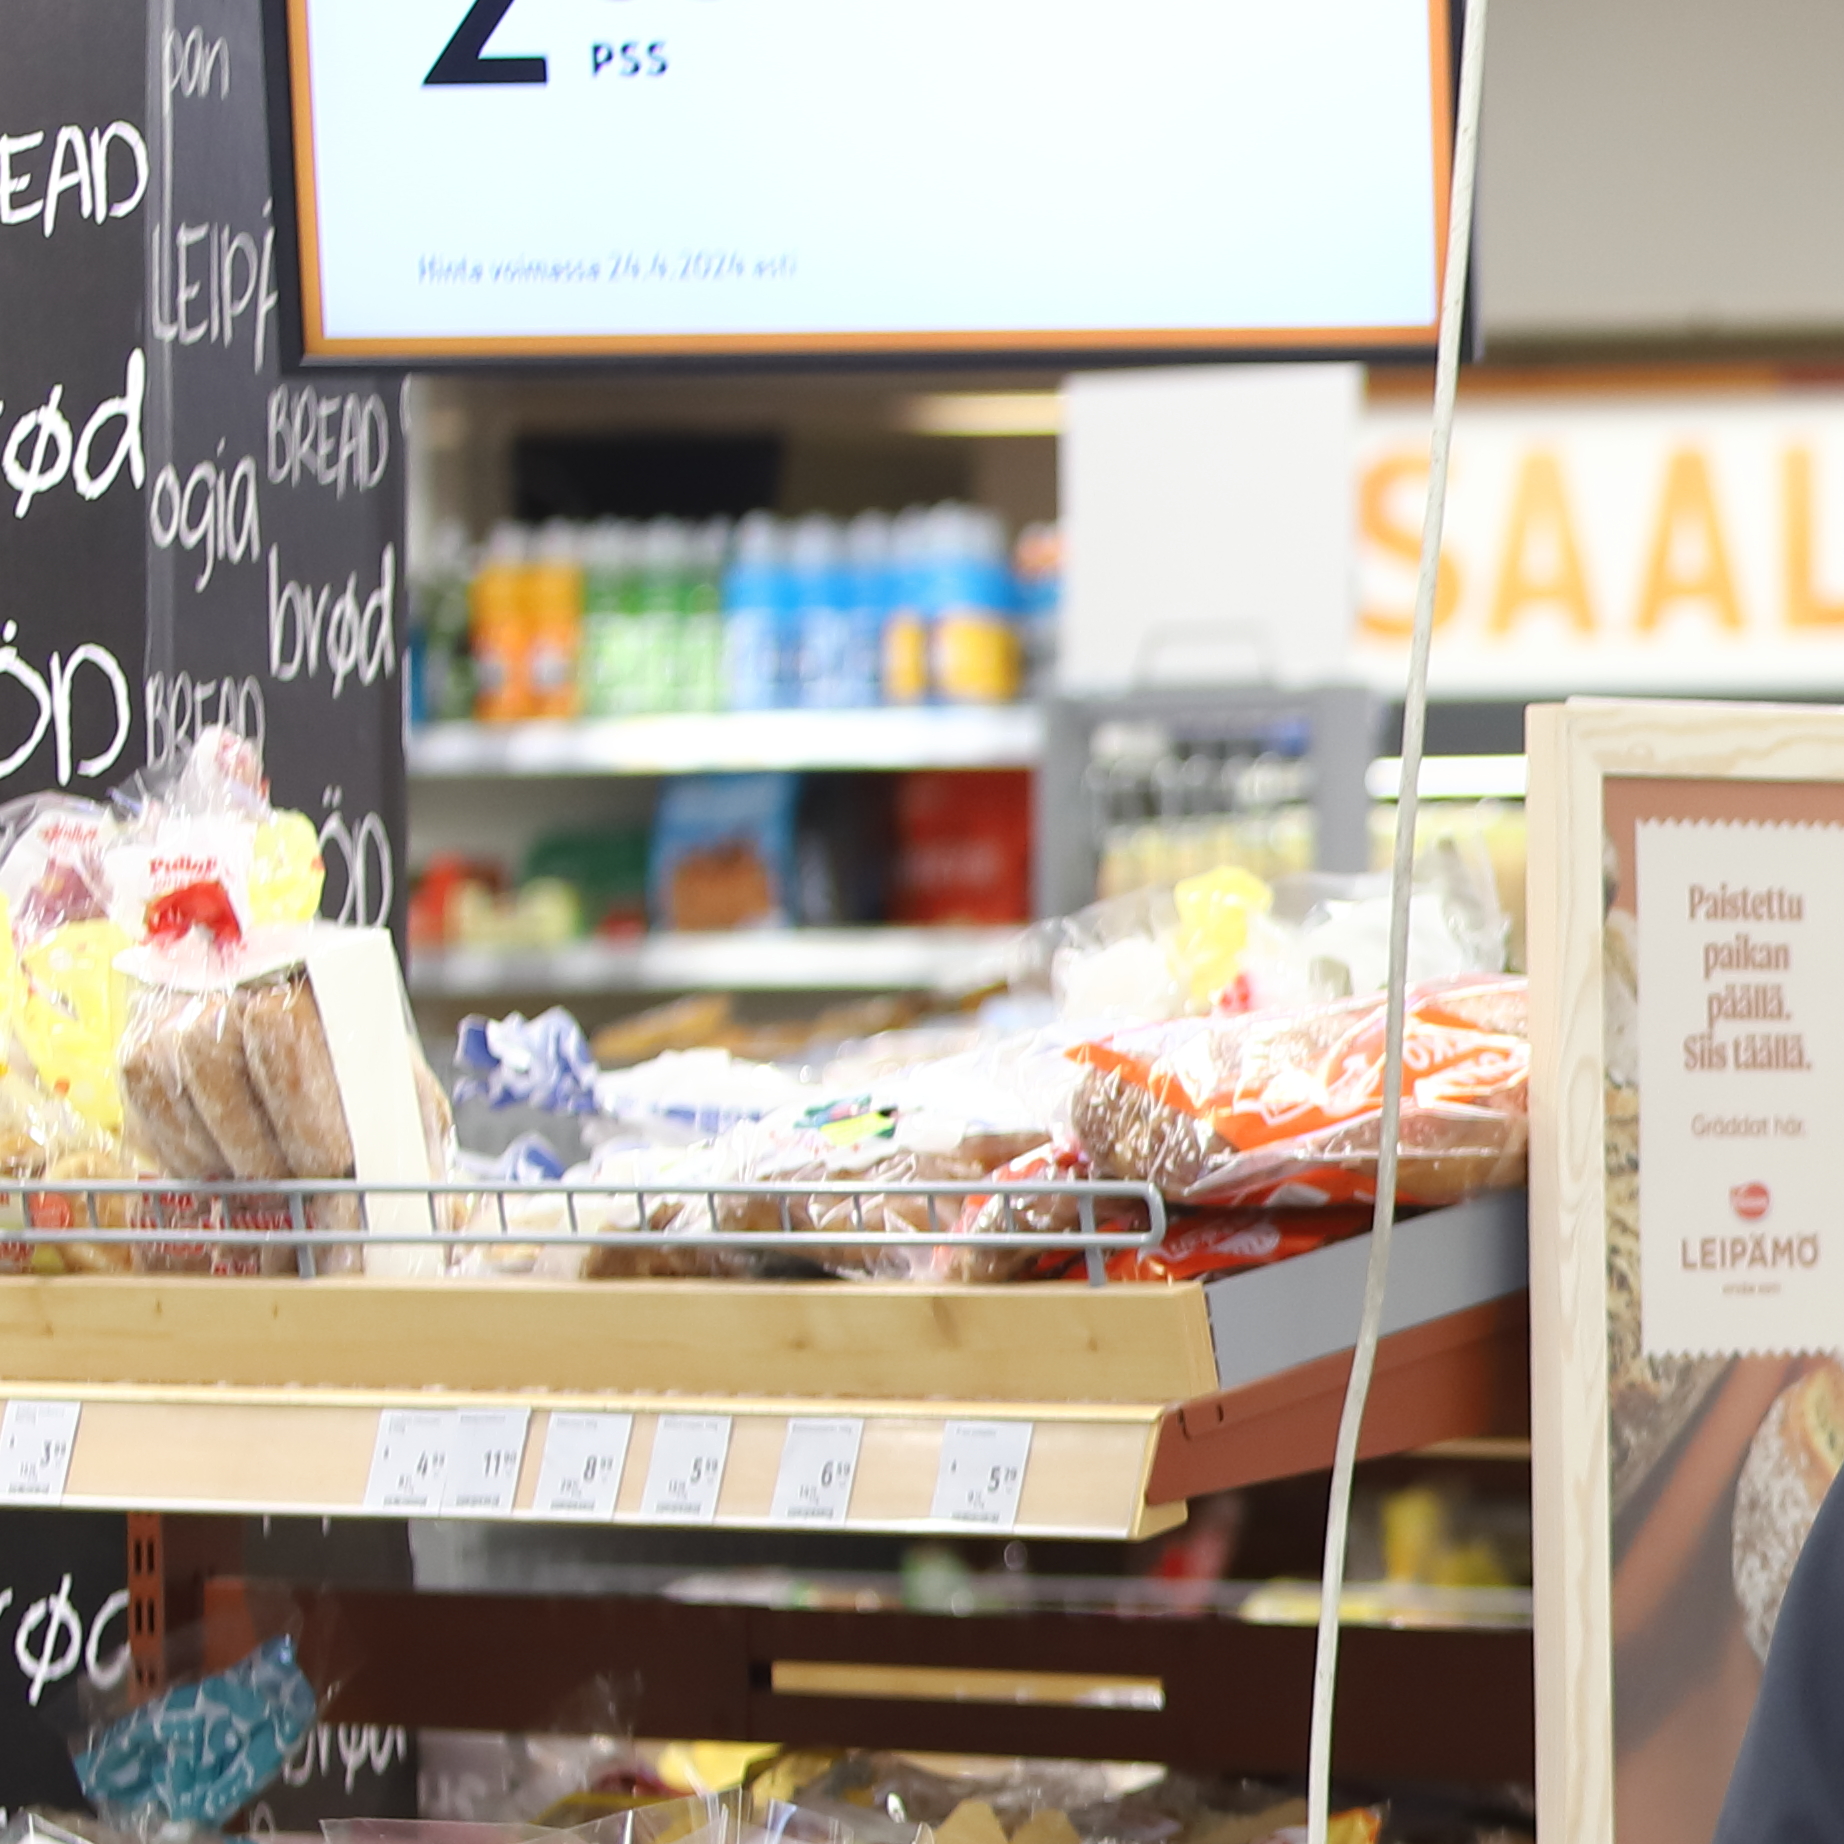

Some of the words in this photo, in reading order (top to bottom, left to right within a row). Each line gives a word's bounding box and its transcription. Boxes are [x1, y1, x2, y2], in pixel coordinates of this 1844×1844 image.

[591, 42, 668, 77] PSS
[267, 384, 389, 500] BREAD
[268, 543, 395, 700] brød
[1689, 882, 1803, 921] Paistettu
[1703, 933, 1790, 980] paikan
[1707, 984, 1791, 1031] päällä.
[1684, 1033, 1727, 1071] Siis
[1733, 1034, 1812, 1071] täällä.
[1681, 1232, 1819, 1270] LEIPÄMÖ
